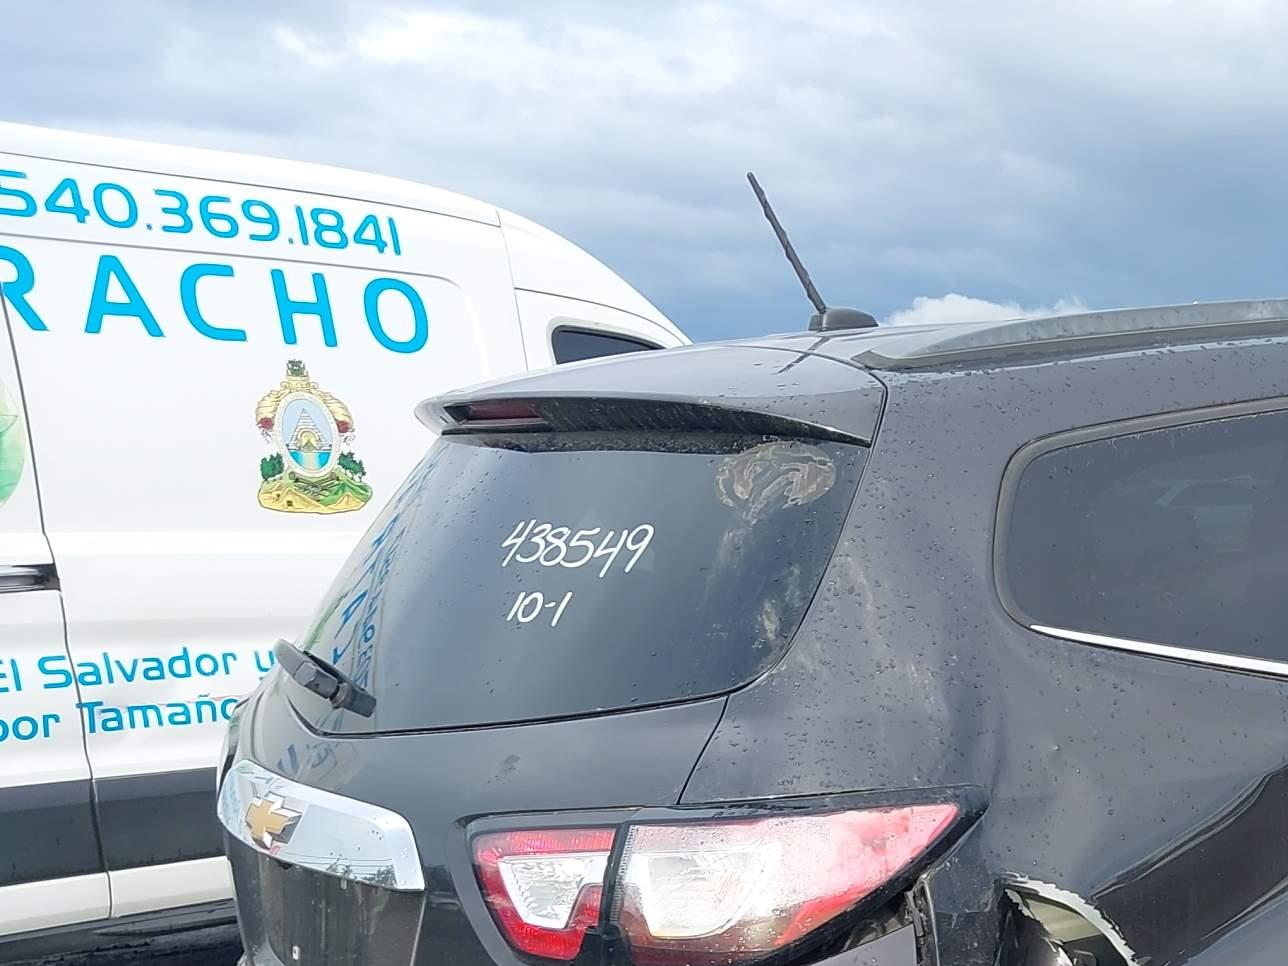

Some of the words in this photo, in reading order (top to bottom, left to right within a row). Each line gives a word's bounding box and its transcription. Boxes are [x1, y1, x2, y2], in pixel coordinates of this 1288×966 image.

[0, 168, 403, 256] 540.369.1841
[0, 240, 430, 355] RACHO
[501, 519, 655, 578] 438549
[506, 591, 573, 627] 10-1
[37, 647, 237, 689] Salvador
